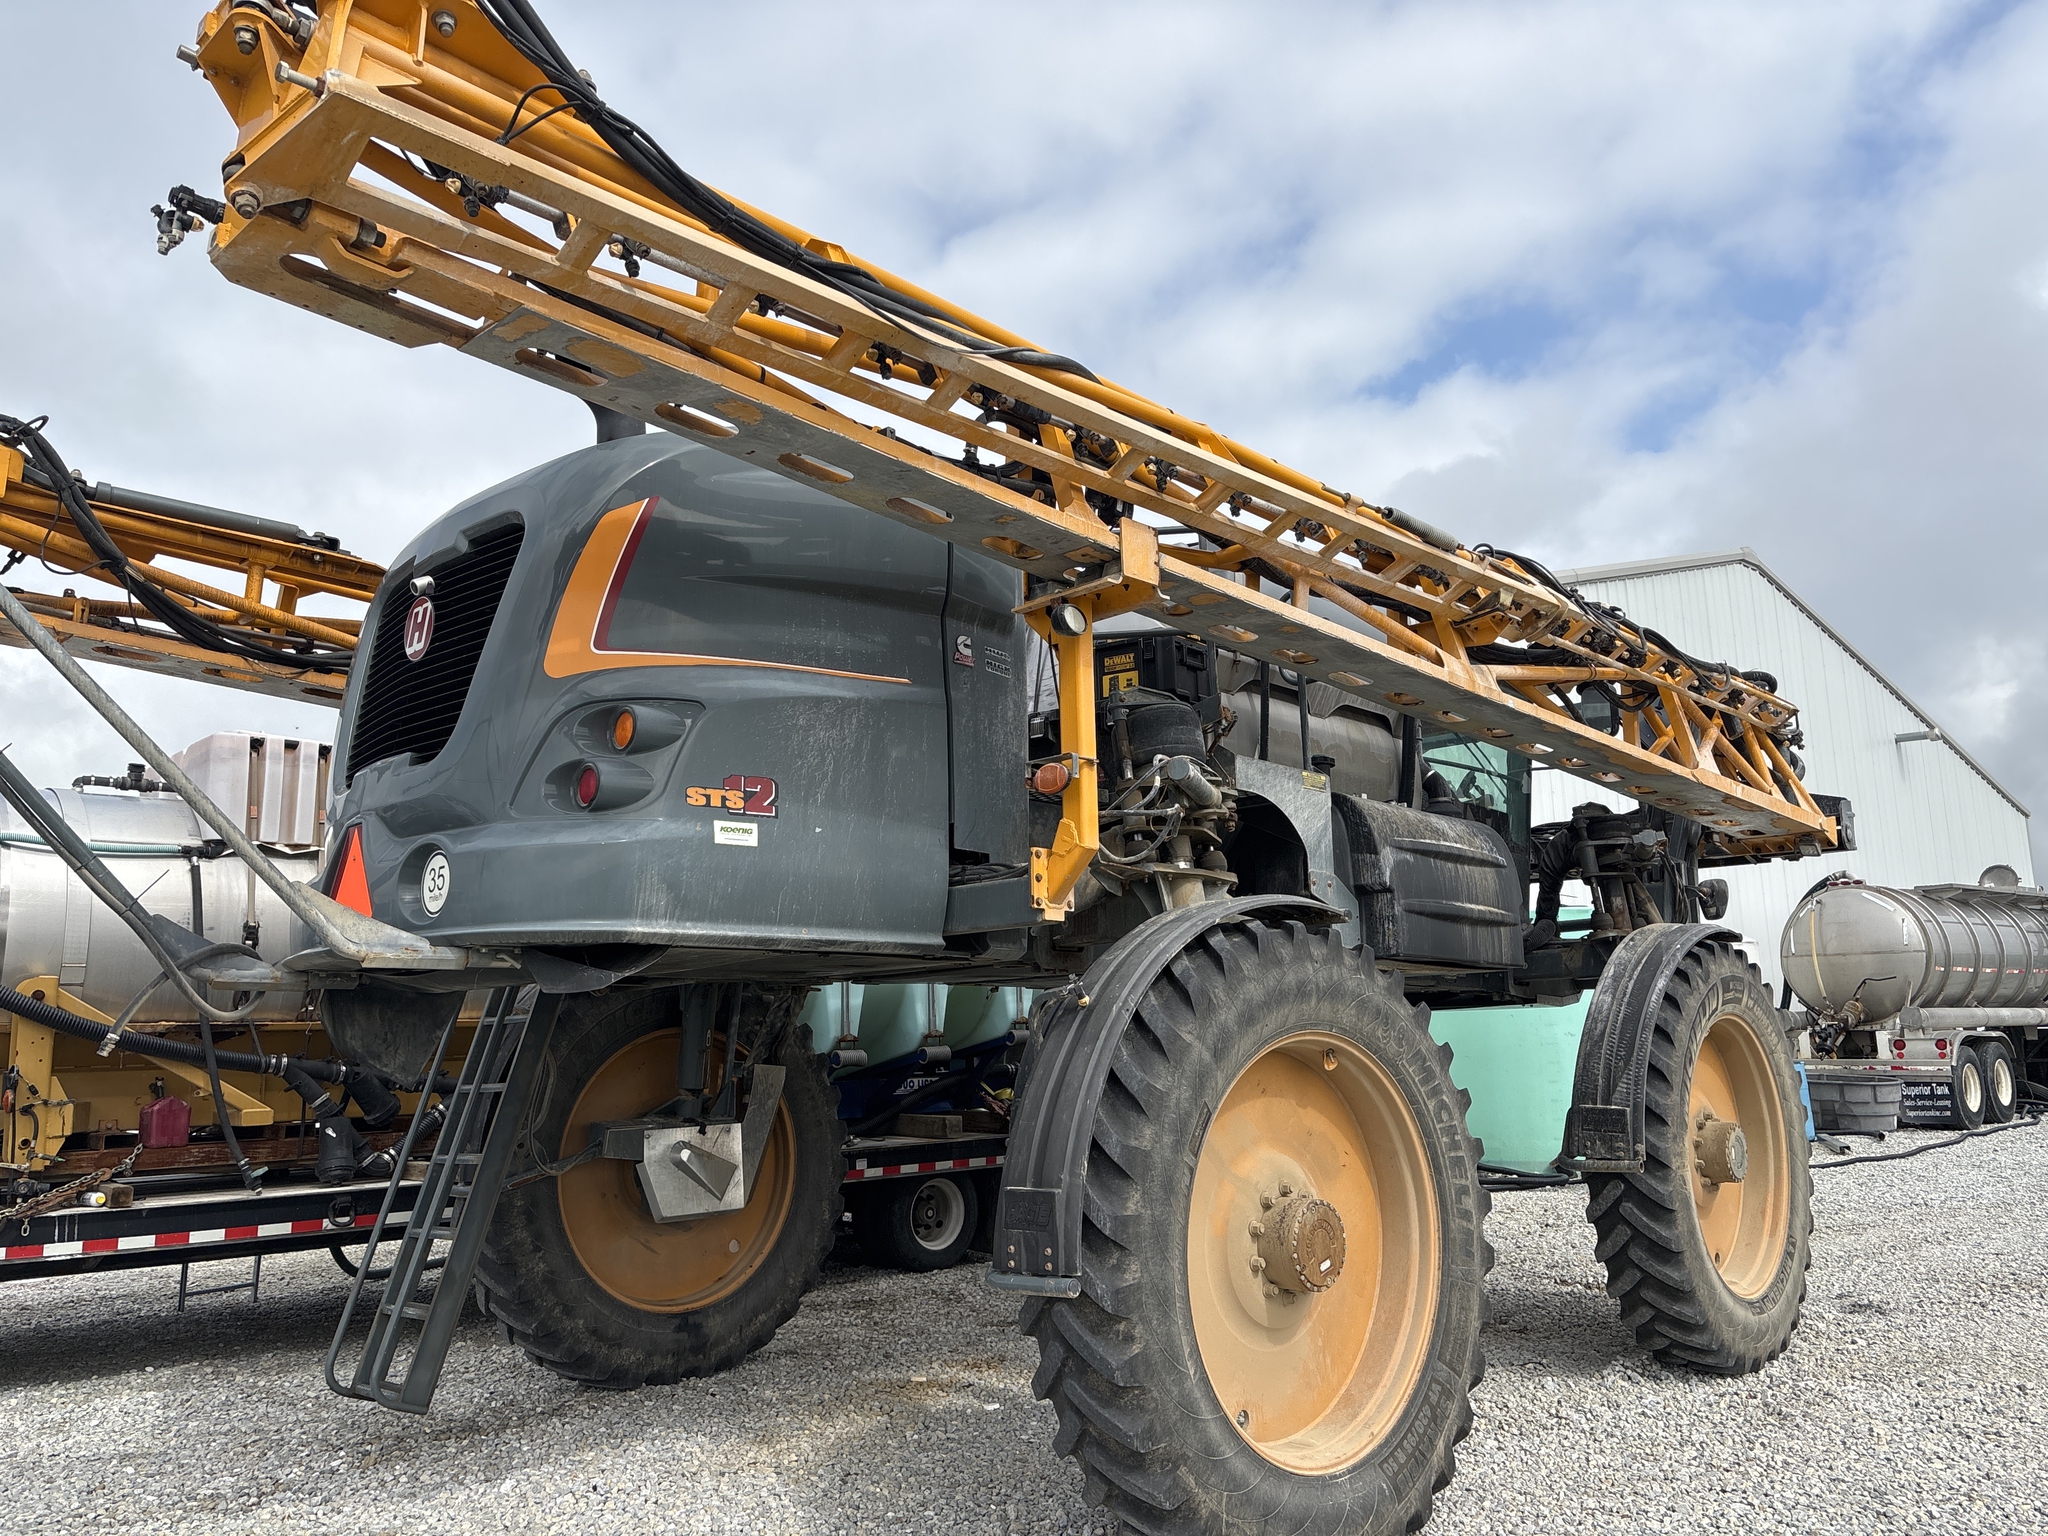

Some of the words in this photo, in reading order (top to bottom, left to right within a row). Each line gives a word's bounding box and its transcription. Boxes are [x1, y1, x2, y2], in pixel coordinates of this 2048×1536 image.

[685, 786, 745, 809] STS
[428, 865, 445, 892] 35
[1902, 1083, 1931, 1098] Superior
[1932, 1083, 1950, 1095] Tank
[1428, 1382, 1441, 1406] VF
[1402, 1404, 1432, 1454] 420/95
[1394, 1447, 1406, 1464] R
[1382, 1459, 1399, 1477] 50
